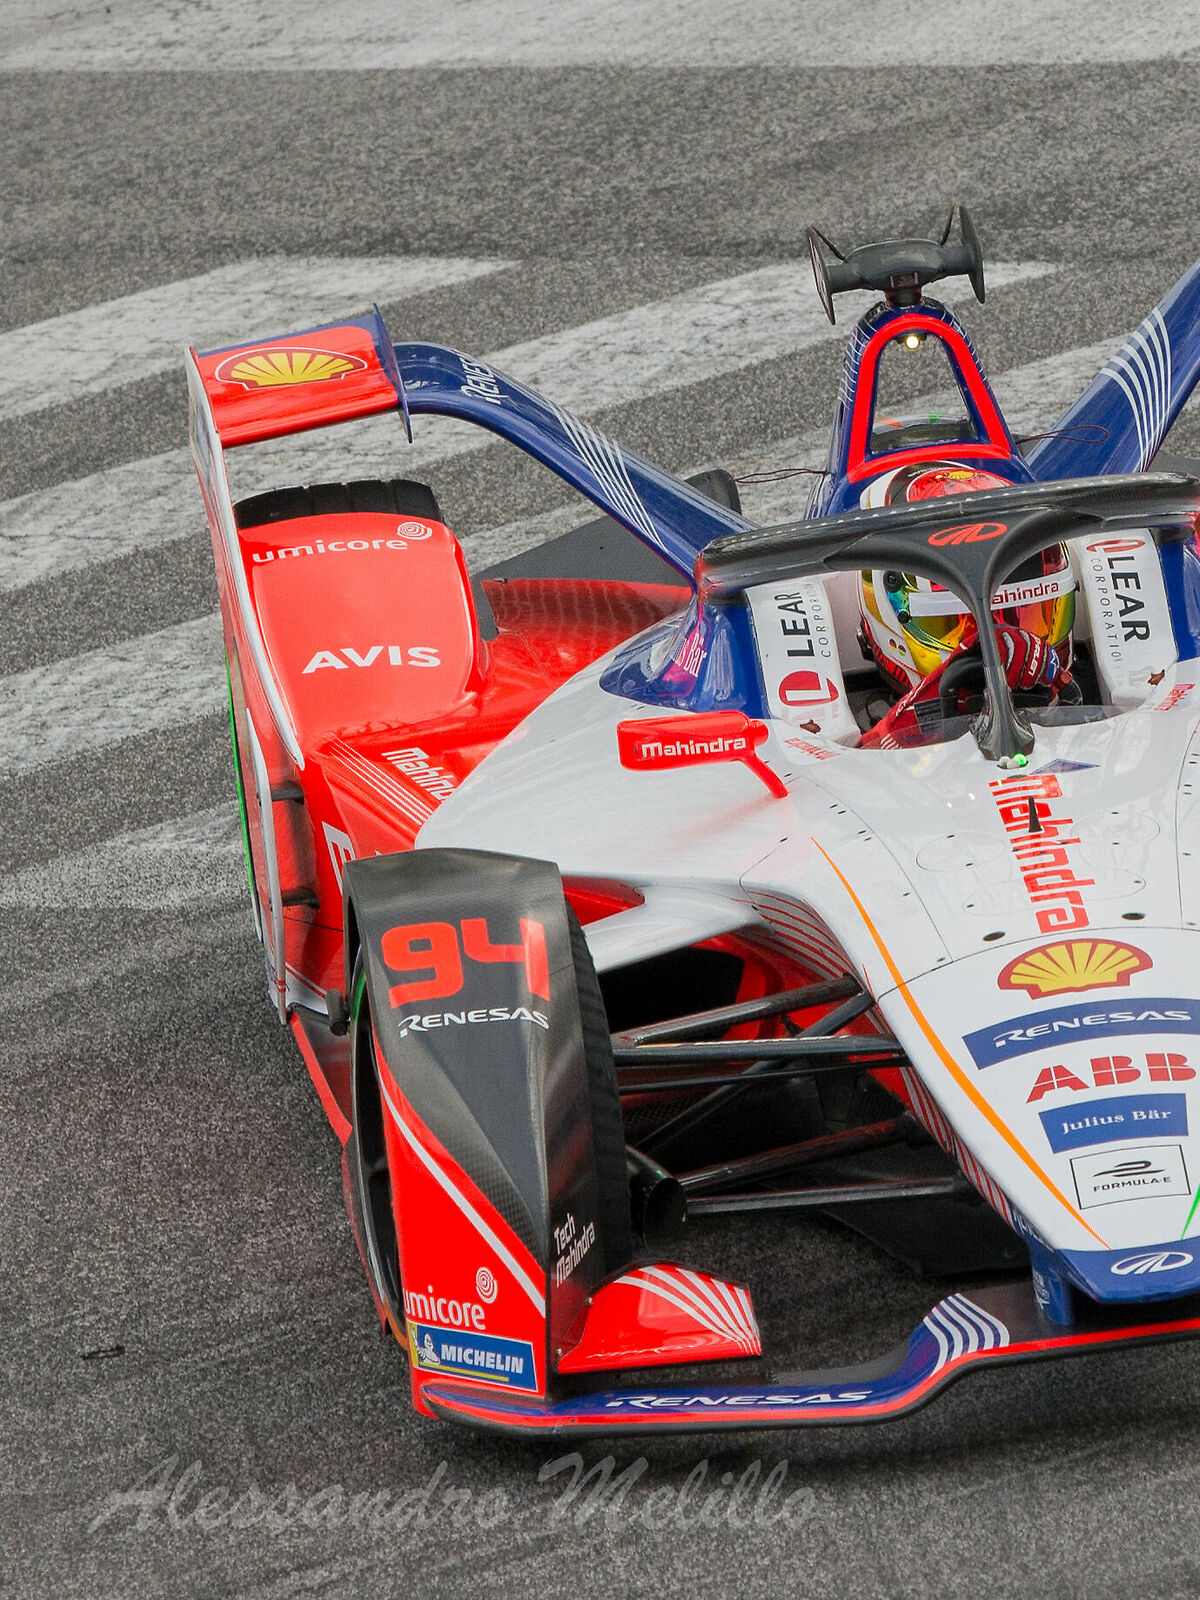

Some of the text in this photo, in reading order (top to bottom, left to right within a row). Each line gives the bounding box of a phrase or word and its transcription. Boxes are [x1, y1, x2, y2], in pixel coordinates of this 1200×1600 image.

[252, 537, 408, 563] umicore
[1107, 556, 1151, 642] LEAR
[773, 591, 815, 657] LEAR
[302, 645, 441, 673] AVIS
[641, 737, 747, 758] Mahindra
[381, 918, 550, 1009] 94
[398, 1007, 549, 1039] RENESAS
[992, 1010, 1192, 1048] RENESAS
[1026, 1053, 1197, 1104] ABB
[1062, 1110, 1172, 1135] Julius Bär
[554, 1213, 576, 1255] Tech
[556, 1222, 595, 1288] Mahindra
[441, 1344, 524, 1374] MICHELIN
[606, 1390, 873, 1408] RENESAS
